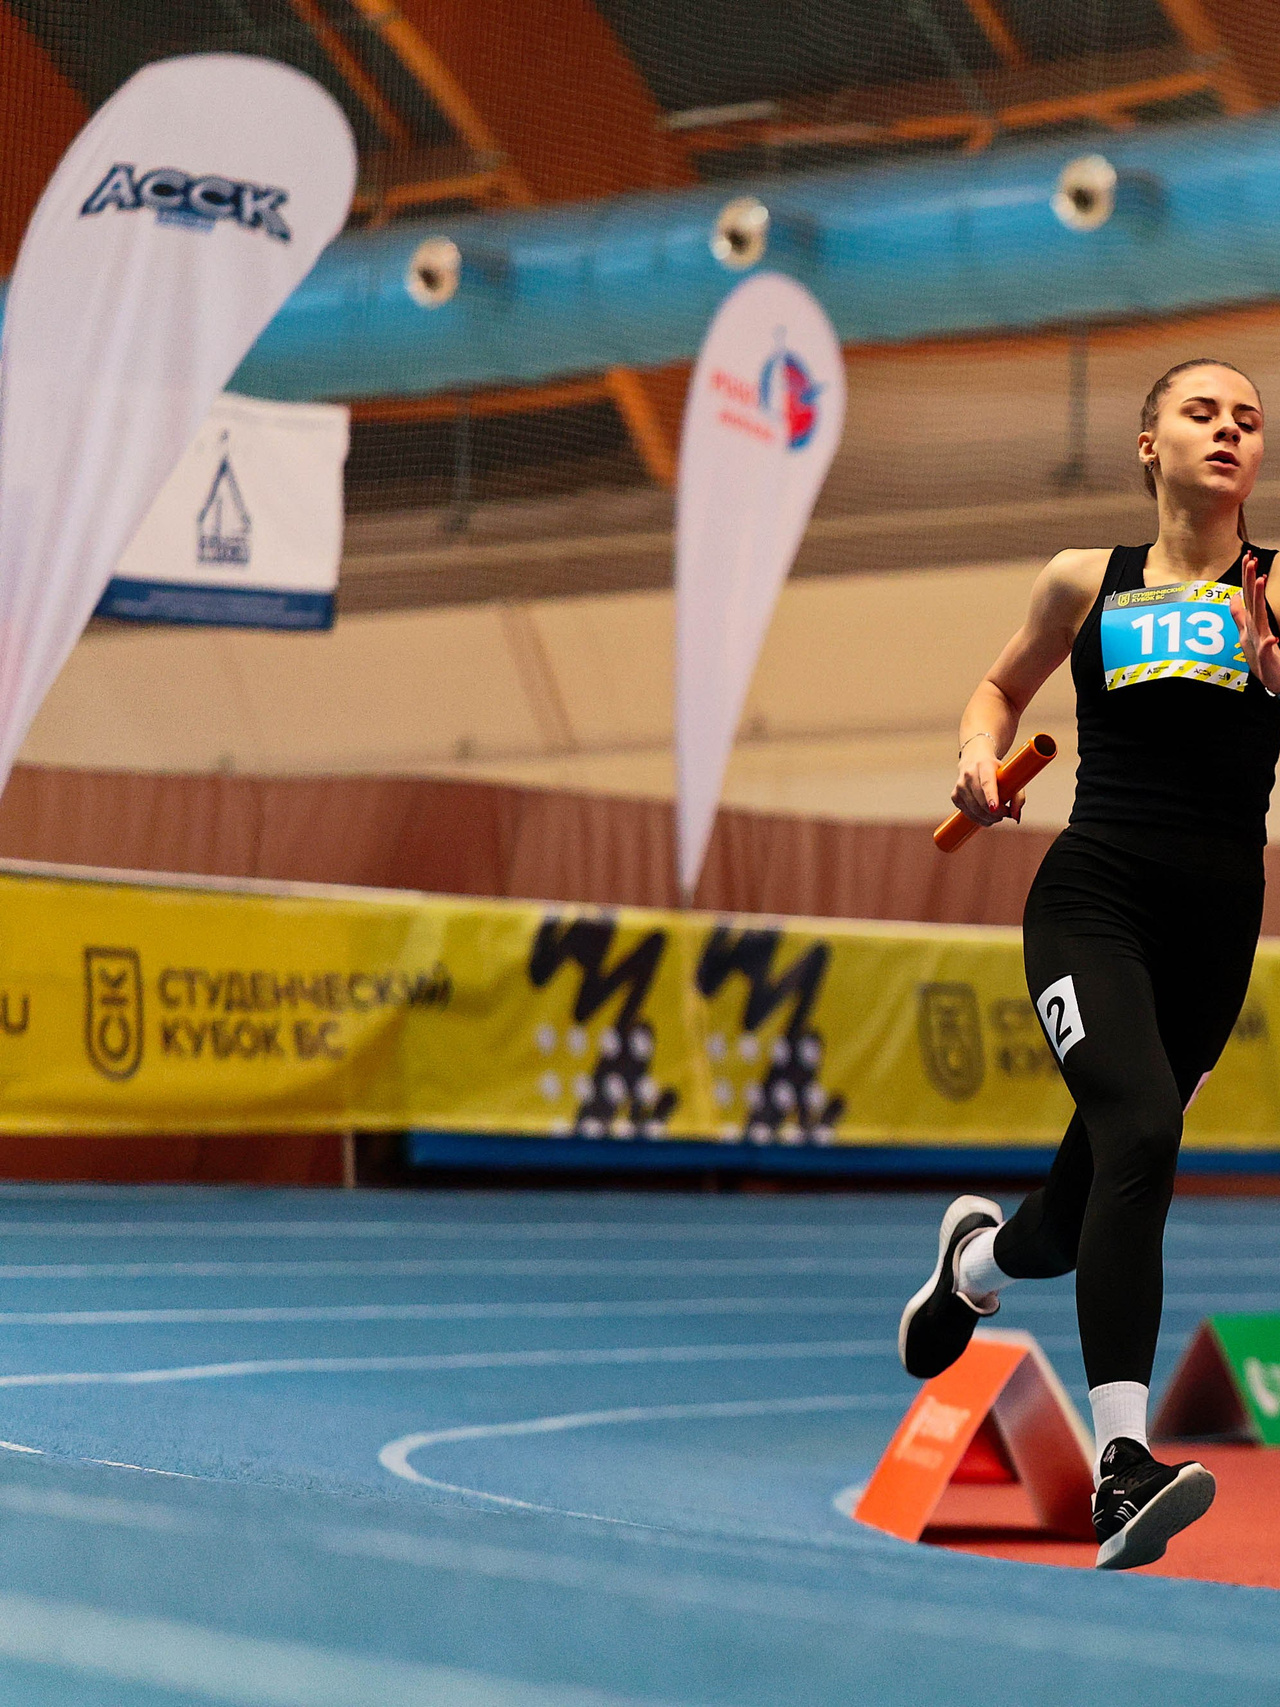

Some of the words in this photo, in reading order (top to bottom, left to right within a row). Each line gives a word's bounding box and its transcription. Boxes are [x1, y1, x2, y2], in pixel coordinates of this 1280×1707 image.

[80, 163, 292, 243] АССК
[1194, 589, 1199, 597] 1
[1205, 589, 1231, 600] ЭТА
[1130, 610, 1225, 656] 113
[157, 962, 453, 1013] СТУДЕНЧЕСКИЙ
[161, 1019, 285, 1060] КУБОК
[293, 1021, 346, 1061] БС
[1046, 995, 1072, 1048] 2
